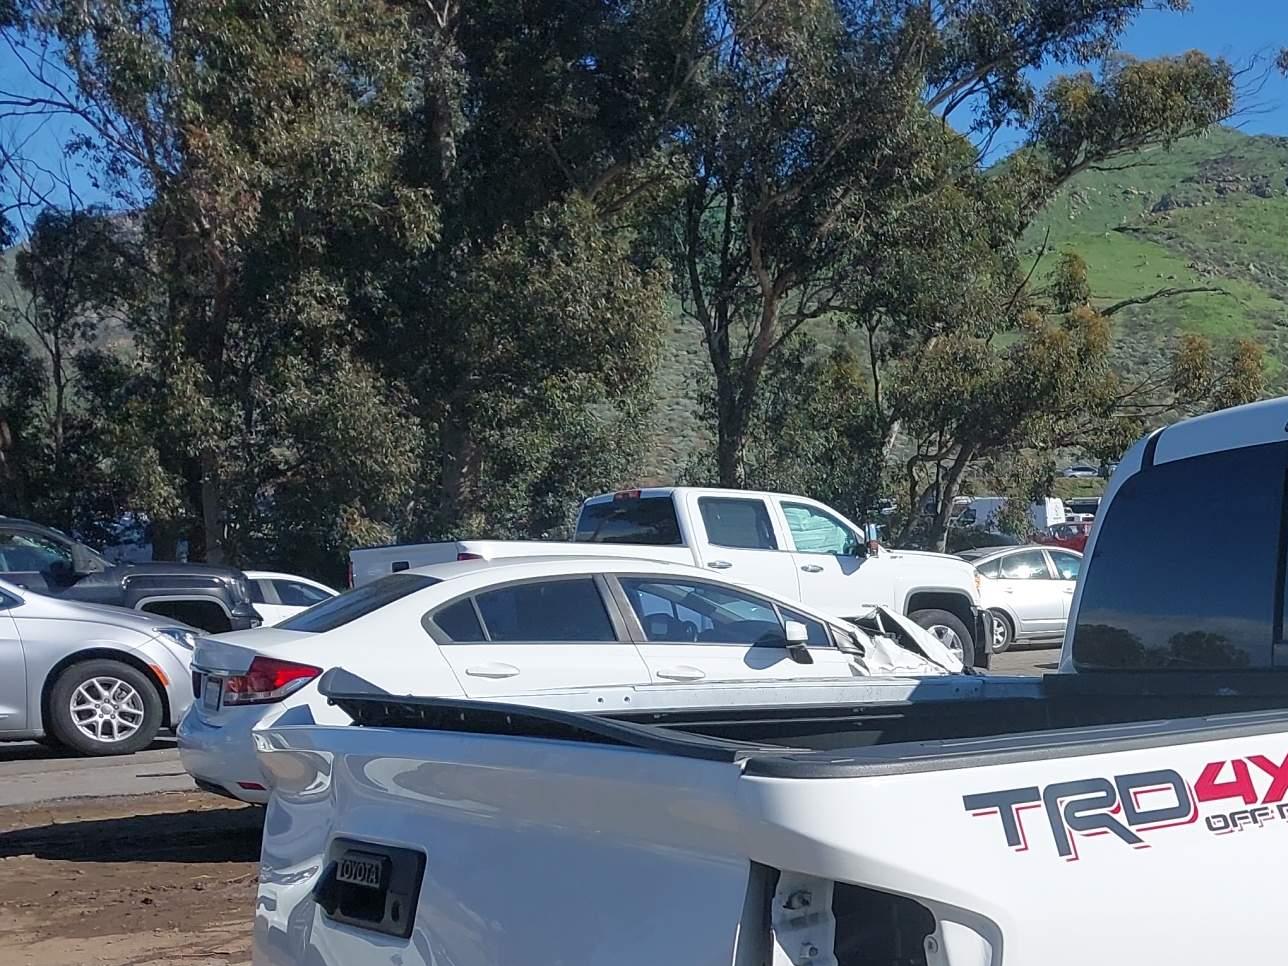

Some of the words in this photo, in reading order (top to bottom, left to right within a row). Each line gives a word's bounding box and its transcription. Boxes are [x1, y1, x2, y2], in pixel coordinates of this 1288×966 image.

[963, 768, 1199, 862] TRD
[1205, 805, 1272, 835] OFF
[336, 859, 379, 887] TOYOTA
